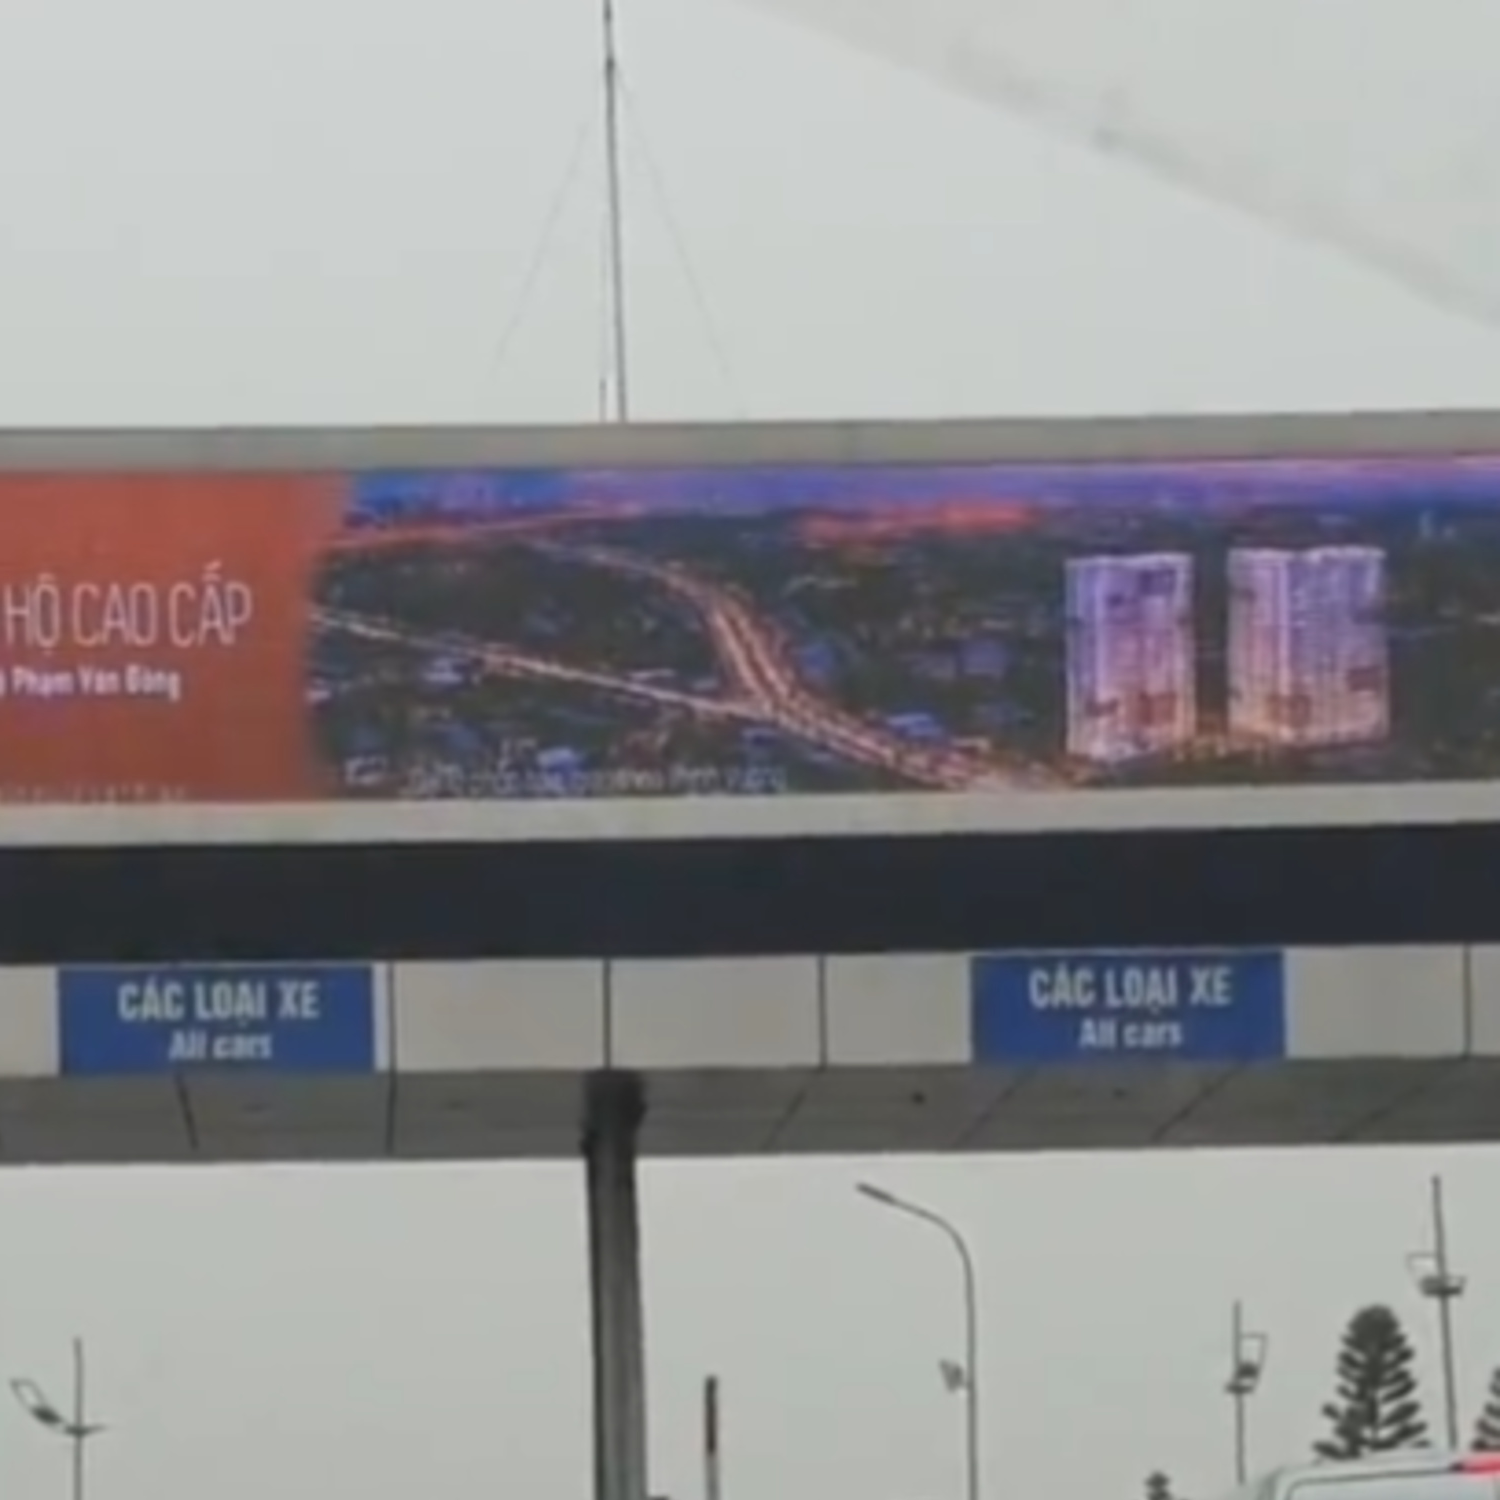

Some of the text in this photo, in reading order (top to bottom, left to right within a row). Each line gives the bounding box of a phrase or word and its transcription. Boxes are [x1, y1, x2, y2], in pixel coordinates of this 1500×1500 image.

[5, 572, 61, 657] HỘ
[71, 582, 158, 647] CAO
[168, 559, 252, 647] CẤP
[117, 976, 321, 1029] CÁC LOẠI XE
[1028, 962, 1234, 1016] CÁC LOẠI XE
[169, 1030, 273, 1060] All cars
[1080, 1017, 1183, 1048] All cars
